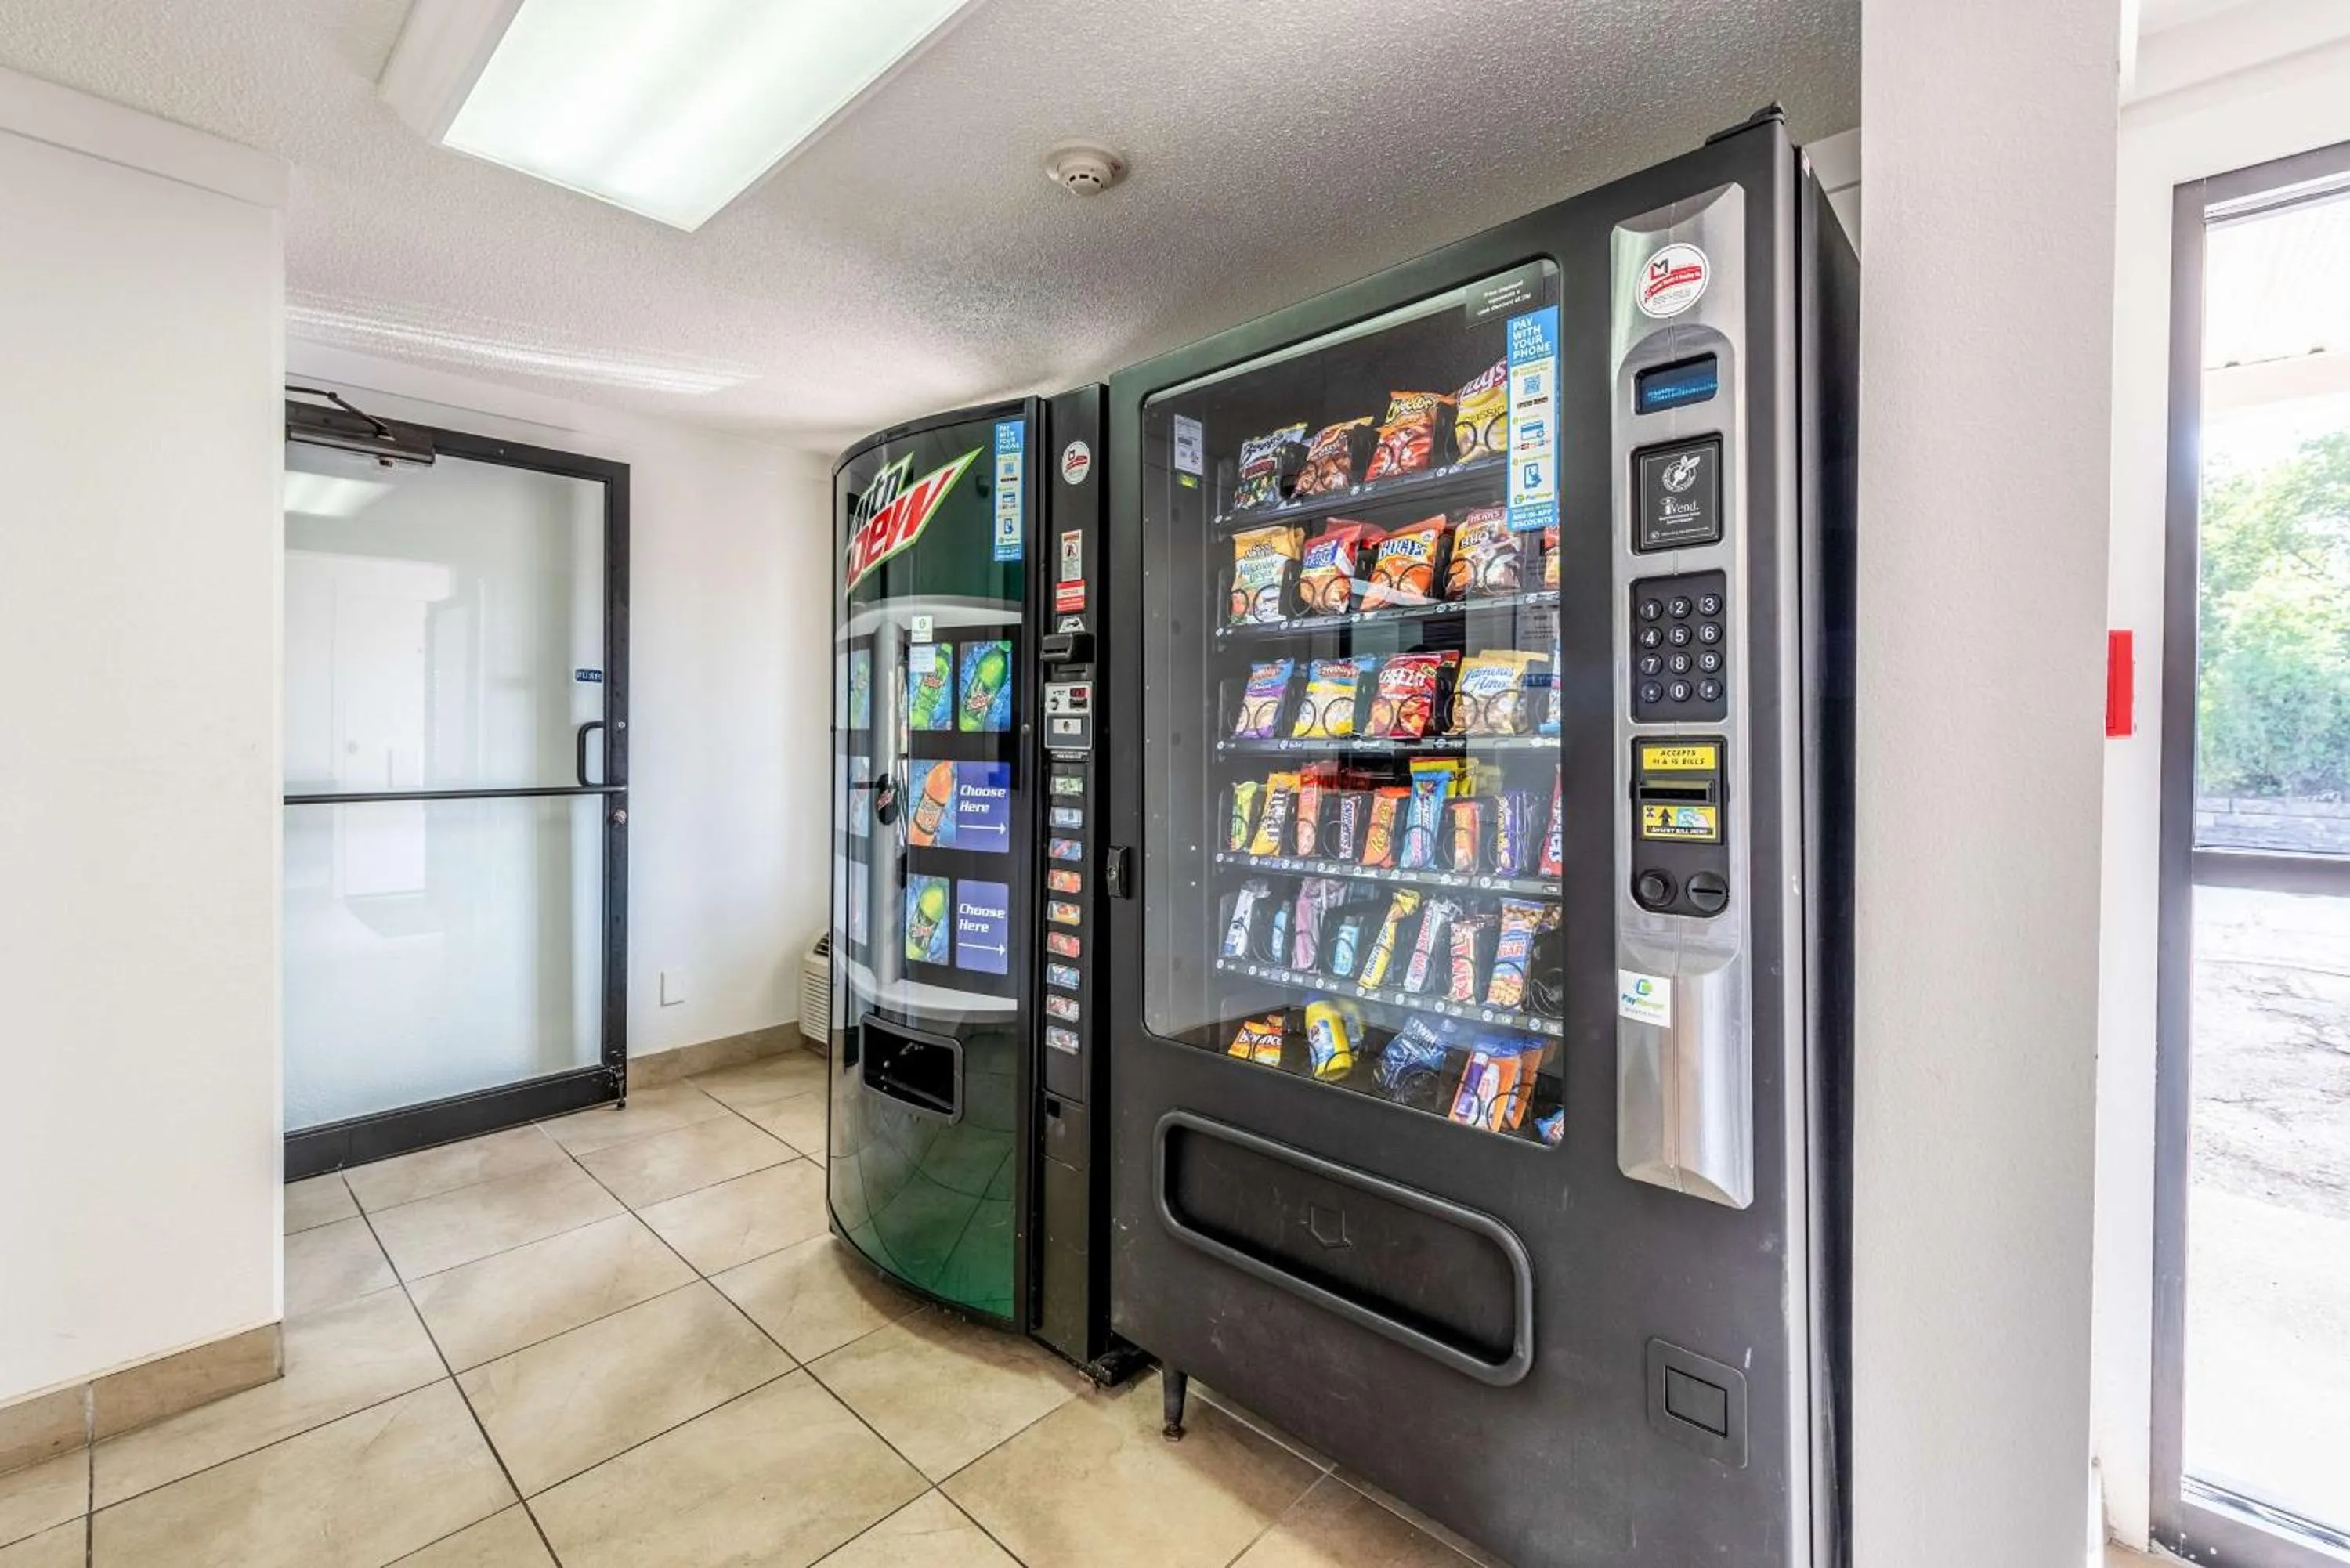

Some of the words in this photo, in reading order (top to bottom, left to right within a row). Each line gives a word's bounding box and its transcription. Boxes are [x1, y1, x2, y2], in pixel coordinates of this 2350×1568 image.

[1513, 316, 1534, 330] PAY
[1513, 324, 1542, 341] WITH
[1513, 334, 1543, 350] YOUR
[1513, 341, 1552, 360] PHONE
[1647, 604, 1654, 617] 1
[1675, 601, 1684, 614] 2
[1704, 598, 1715, 612] 3
[1645, 630, 1655, 645] 4
[1675, 629, 1684, 643] 5
[1704, 626, 1715, 640] 6
[1647, 659, 1655, 673] 7
[1675, 656, 1685, 670] 8
[1705, 655, 1715, 668] 9
[1675, 685, 1684, 698] 0
[960, 784, 1007, 799] Choose
[959, 800, 990, 814] Here
[959, 902, 1006, 919] Choose
[958, 919, 990, 934] Here
